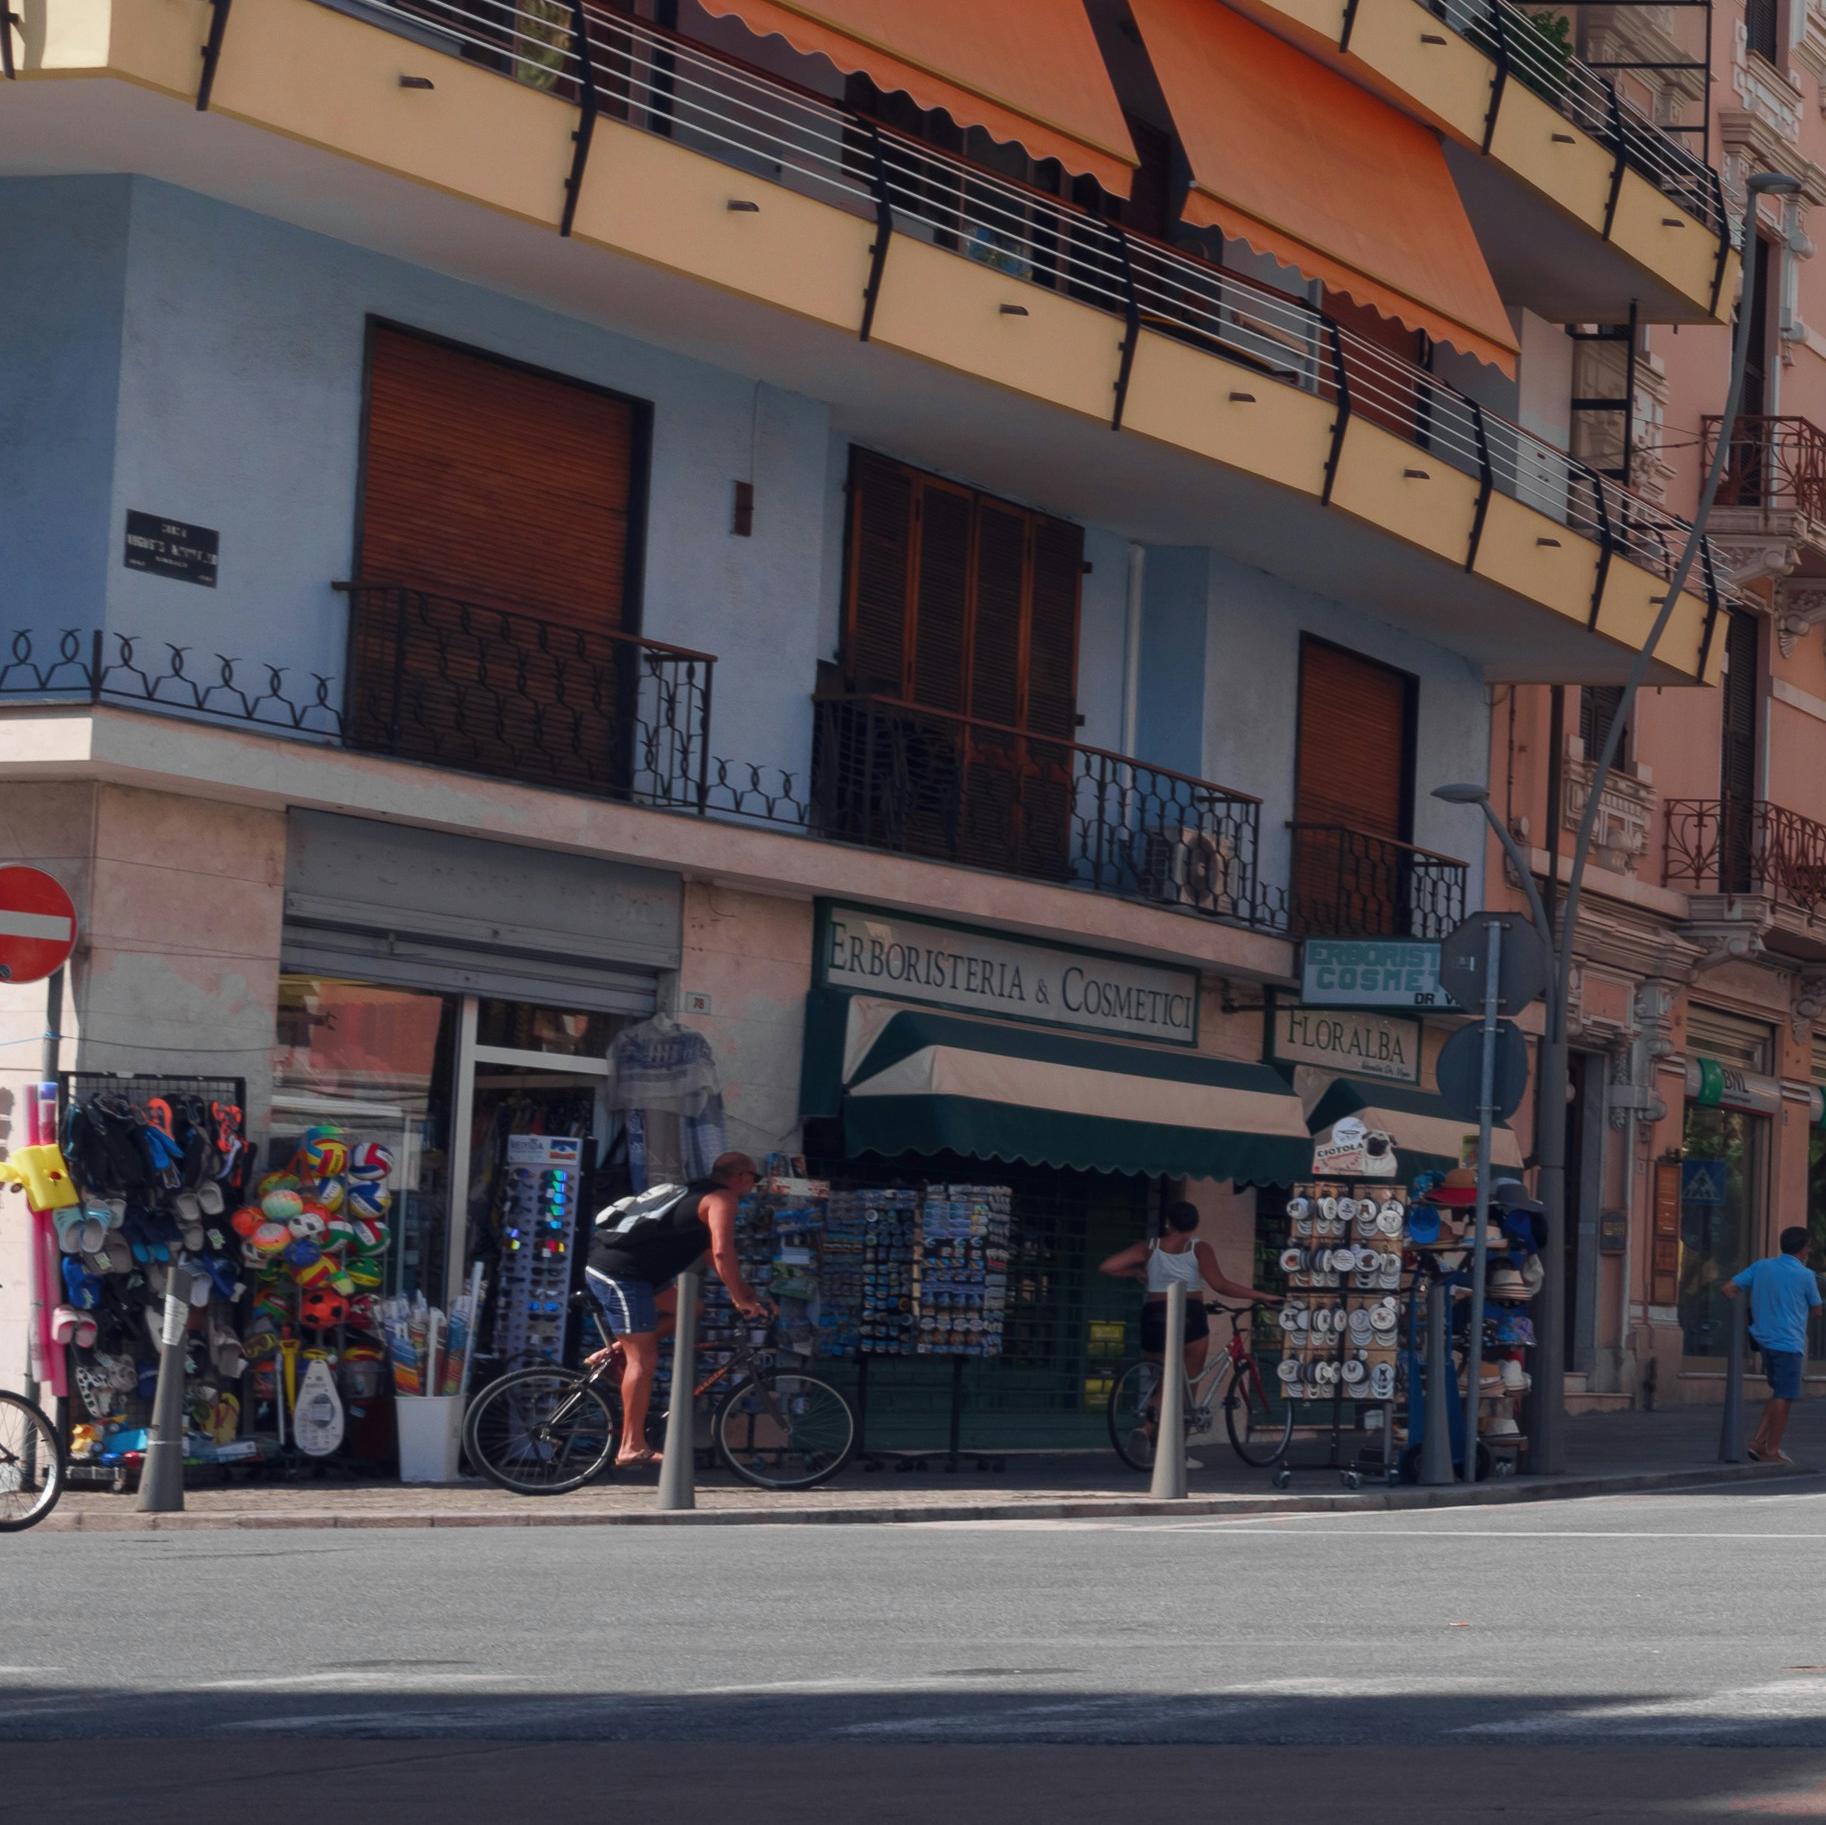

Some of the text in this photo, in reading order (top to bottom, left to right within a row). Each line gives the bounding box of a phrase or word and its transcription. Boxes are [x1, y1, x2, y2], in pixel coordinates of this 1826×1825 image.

[1307, 941, 1441, 969] ERBORIST
[828, 921, 1192, 1029] ERBORISTERIA & COSMETICI
[1315, 966, 1441, 992] COSMET
[1414, 993, 1435, 1005] DR
[1288, 1006, 1405, 1065] FLORALBA
[1722, 1068, 1750, 1094] BNL
[1317, 1142, 1364, 1158] CIOTOLA
